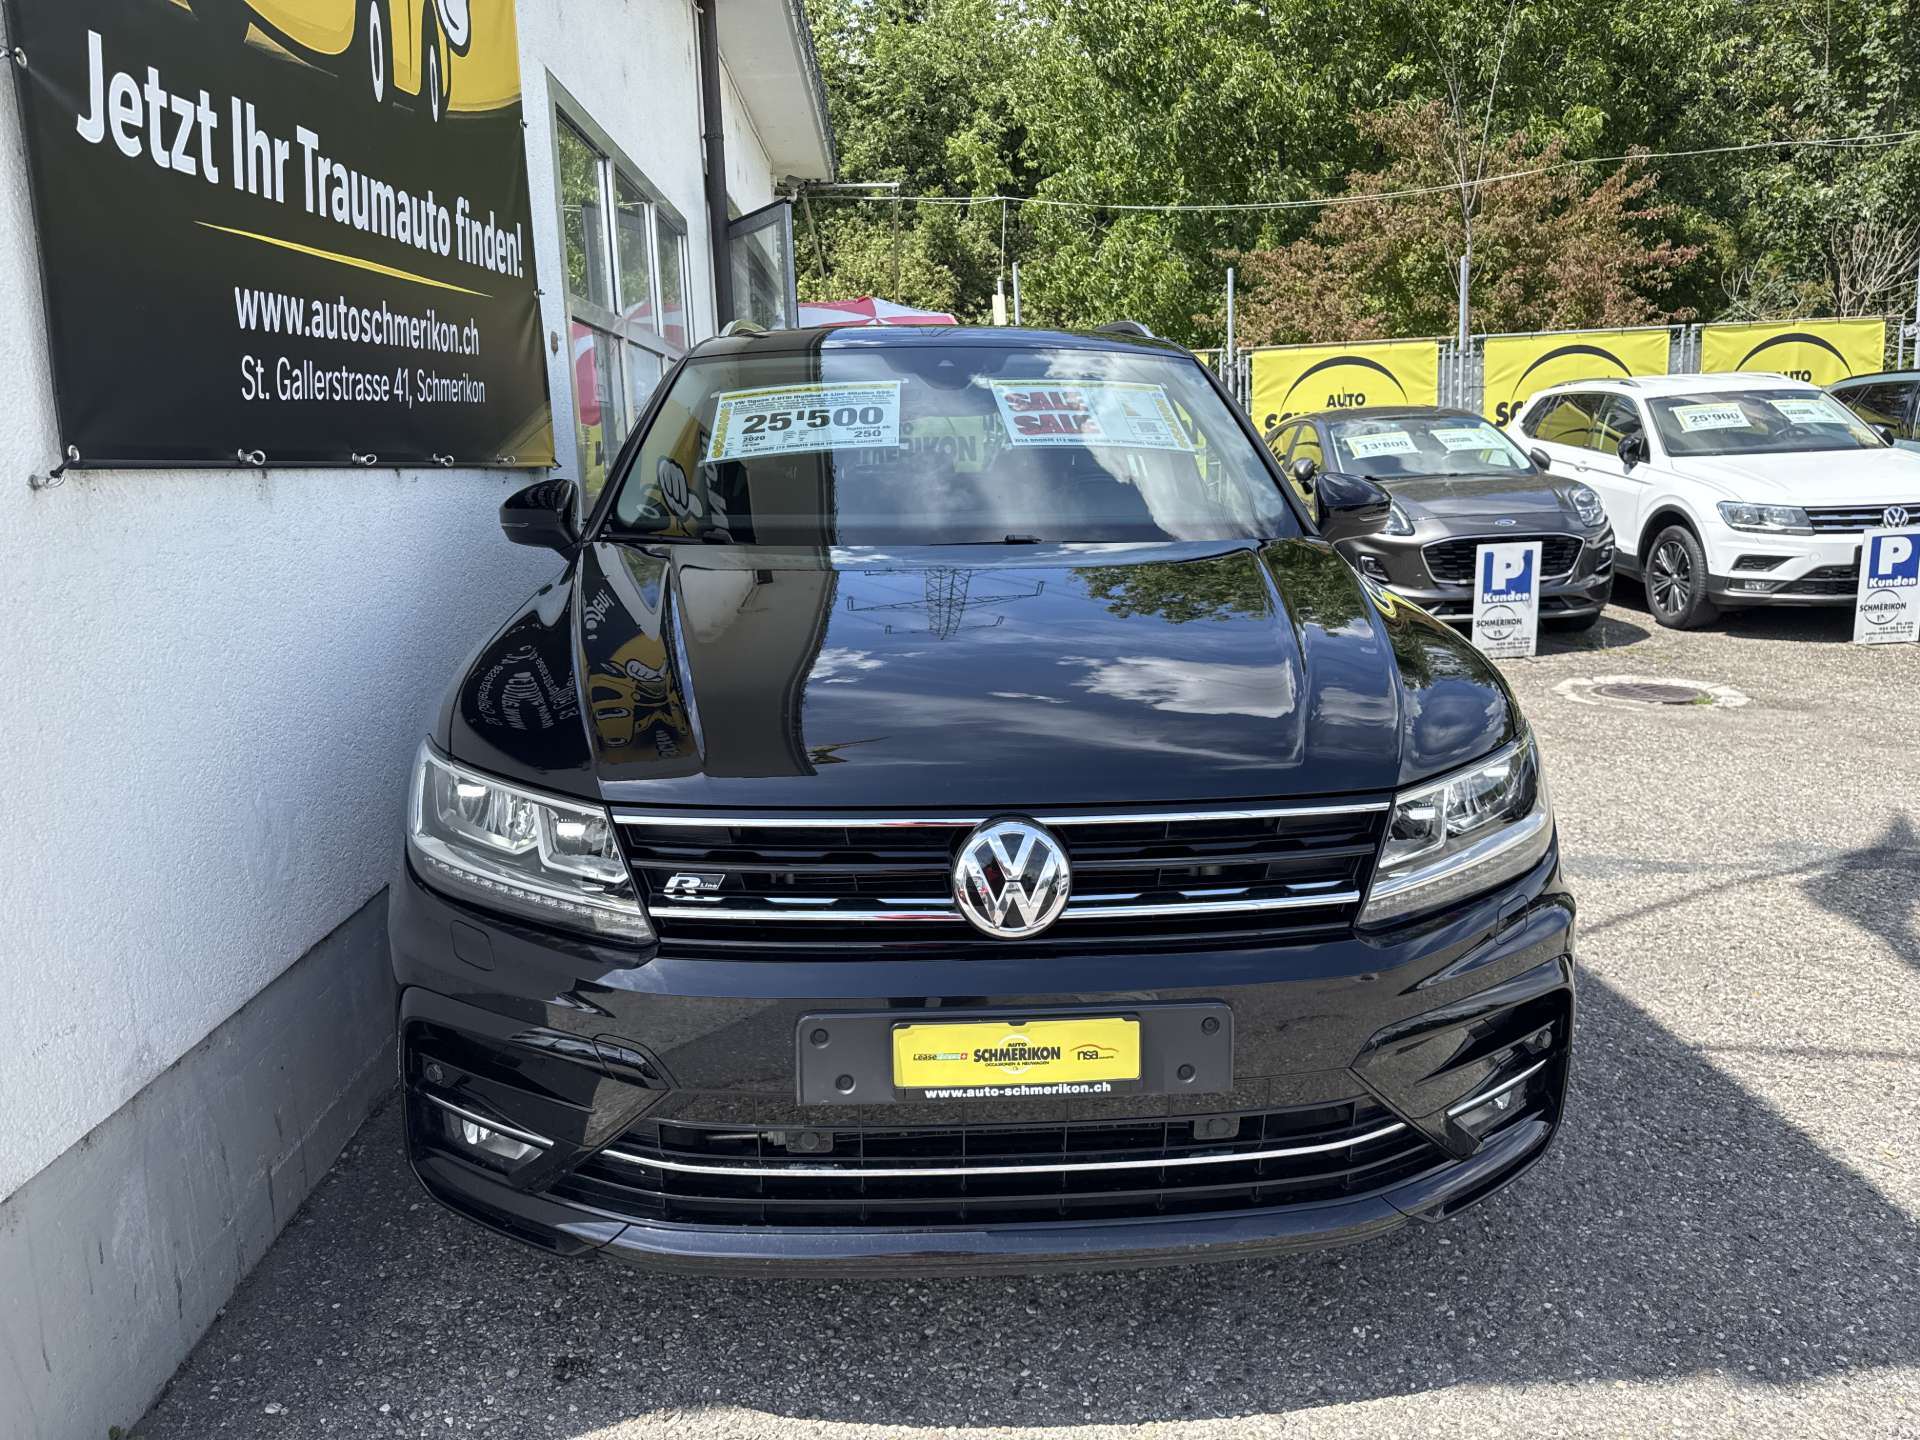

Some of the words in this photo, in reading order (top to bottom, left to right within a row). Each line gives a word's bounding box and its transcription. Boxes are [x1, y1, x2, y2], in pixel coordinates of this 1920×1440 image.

[76, 30, 219, 184] Jetzt
[231, 96, 288, 203] Ihr
[297, 125, 451, 256] Traumauto
[456, 197, 523, 278] finden!
[234, 286, 480, 355] www.autoschmerikon.ch
[241, 355, 271, 401] St.
[276, 357, 390, 402] Gallerstrasse
[394, 368, 413, 408] 41,
[417, 371, 486, 403] Schmerikon
[1326, 392, 1366, 409] AUTO
[742, 406, 884, 434] 25'500
[853, 429, 882, 438] 250
[1878, 536, 1912, 575] P
[1491, 547, 1525, 590] P
[1869, 575, 1917, 588] Kunden
[1483, 590, 1530, 603] Kunden
[1859, 602, 1907, 613] SCHMERIKON
[973, 1046, 1061, 1063] SCHMERIKON
[1077, 1050, 1099, 1060] nsa
[925, 1081, 1112, 1099] www.auto-schmerikon.ch
